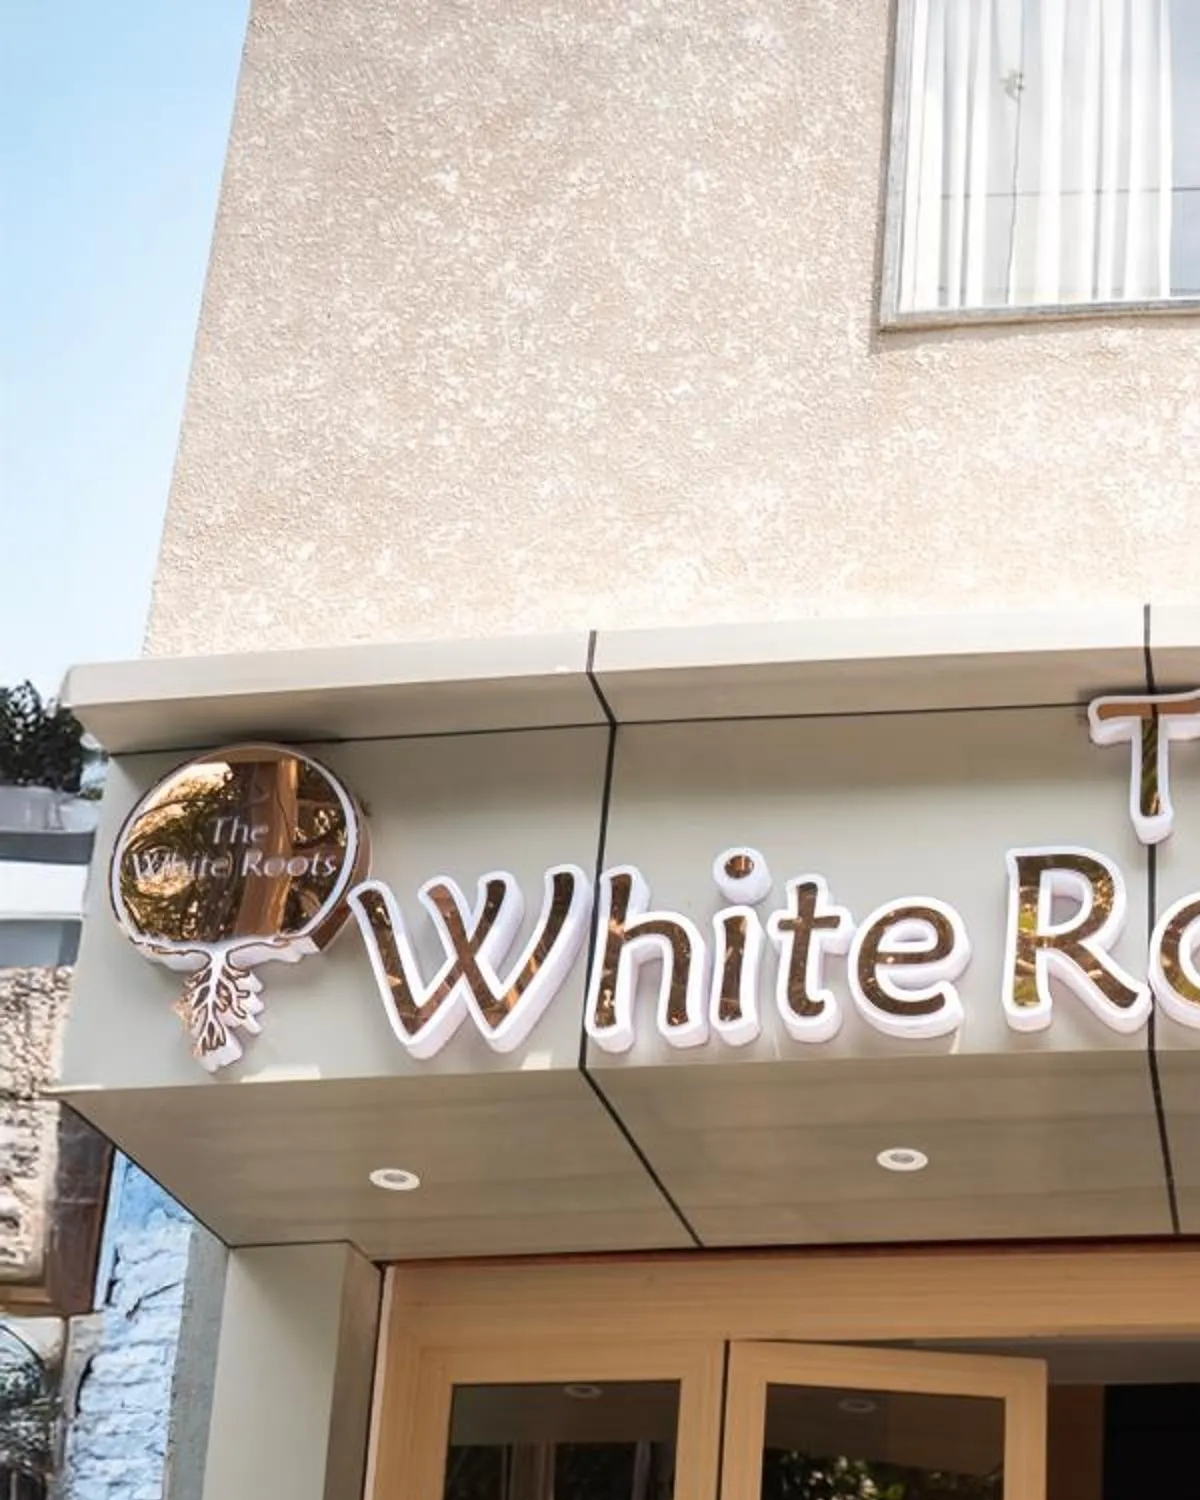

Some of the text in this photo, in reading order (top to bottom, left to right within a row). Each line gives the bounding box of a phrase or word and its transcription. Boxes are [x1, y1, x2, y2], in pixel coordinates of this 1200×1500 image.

[209, 814, 270, 845] The
[130, 850, 338, 880] White Roots
[347, 847, 972, 1060] White
